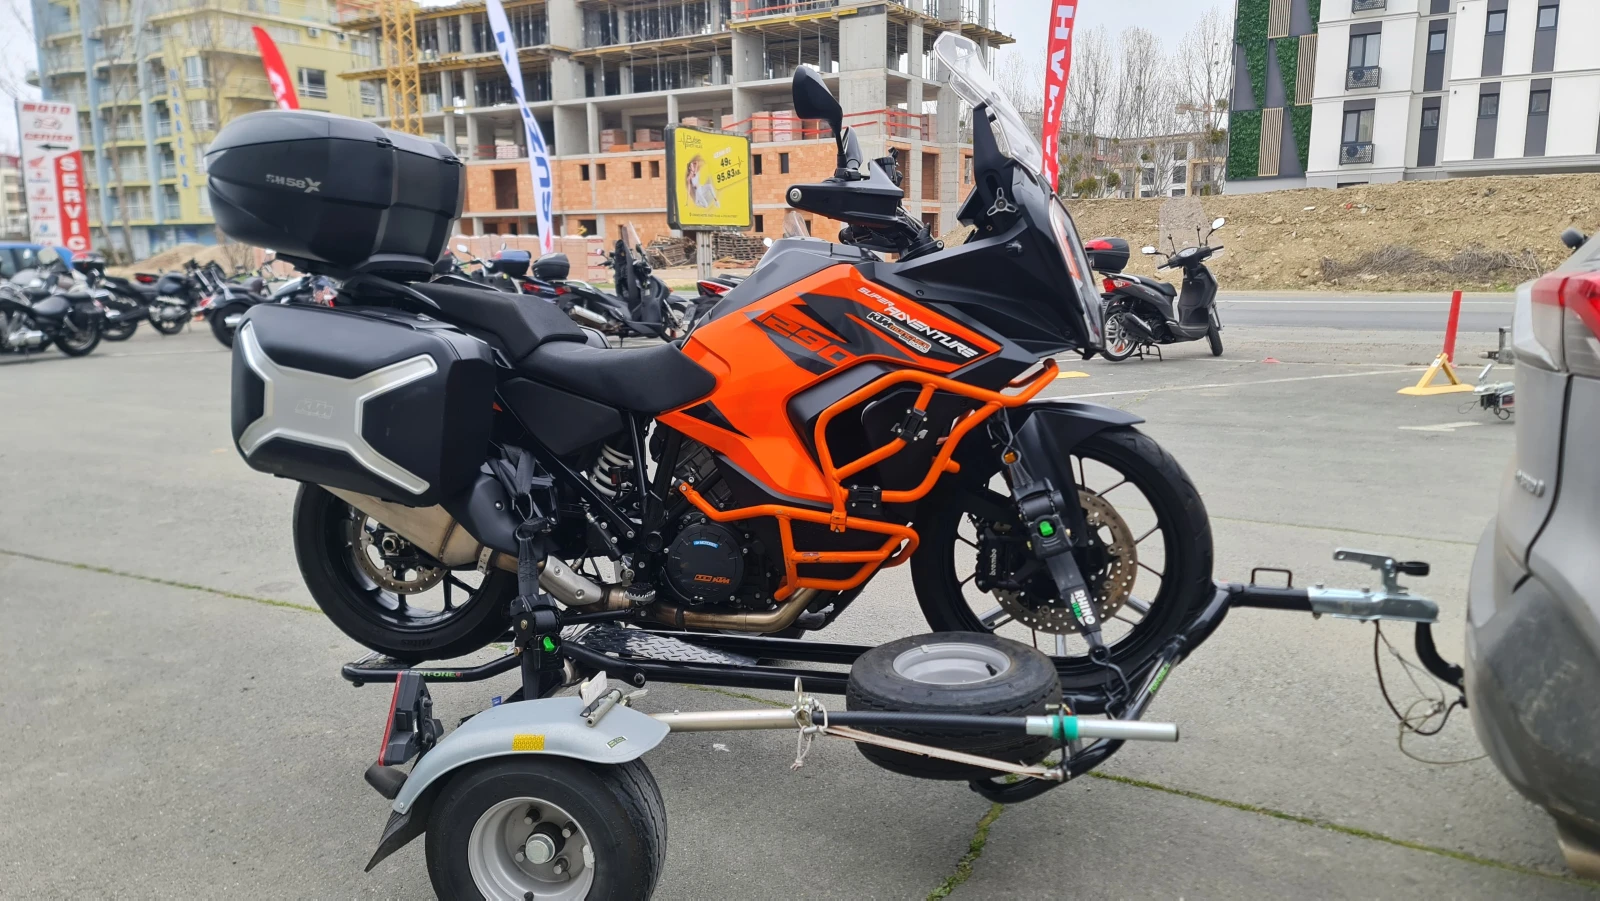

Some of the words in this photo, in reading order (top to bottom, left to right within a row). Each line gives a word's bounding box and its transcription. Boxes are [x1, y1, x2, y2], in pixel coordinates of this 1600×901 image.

[265, 174, 321, 193] SH58X
[59, 156, 87, 251] SERVIC
[857, 286, 896, 307] SUPER
[756, 311, 858, 367] 1290
[883, 305, 978, 358] ADVENTURE
[989, 548, 998, 576] brembo
[1074, 589, 1096, 625] RHINO
